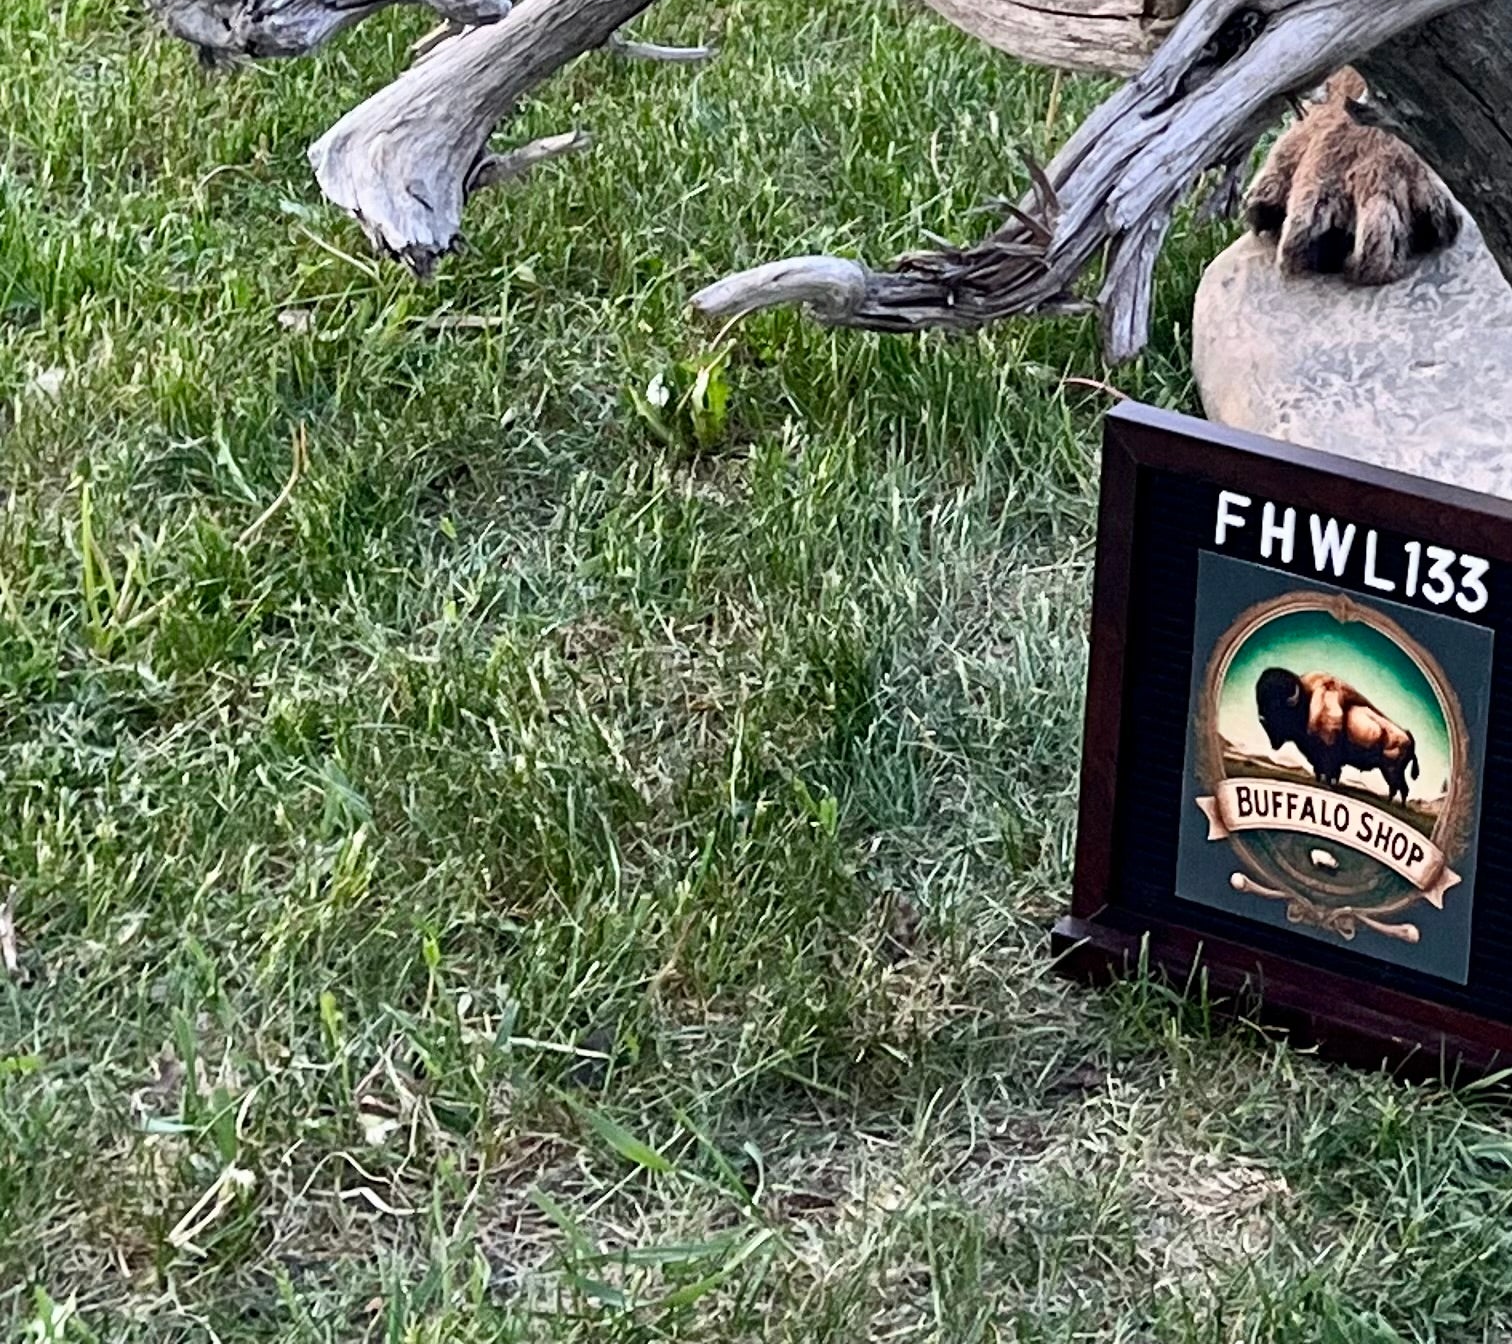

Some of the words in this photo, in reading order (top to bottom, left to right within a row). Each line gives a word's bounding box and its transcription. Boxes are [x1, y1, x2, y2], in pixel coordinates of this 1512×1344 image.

[1215, 490, 1490, 613] FHWL133
[1236, 785, 1350, 832] BUFFALO
[1356, 812, 1425, 867] SHOP
